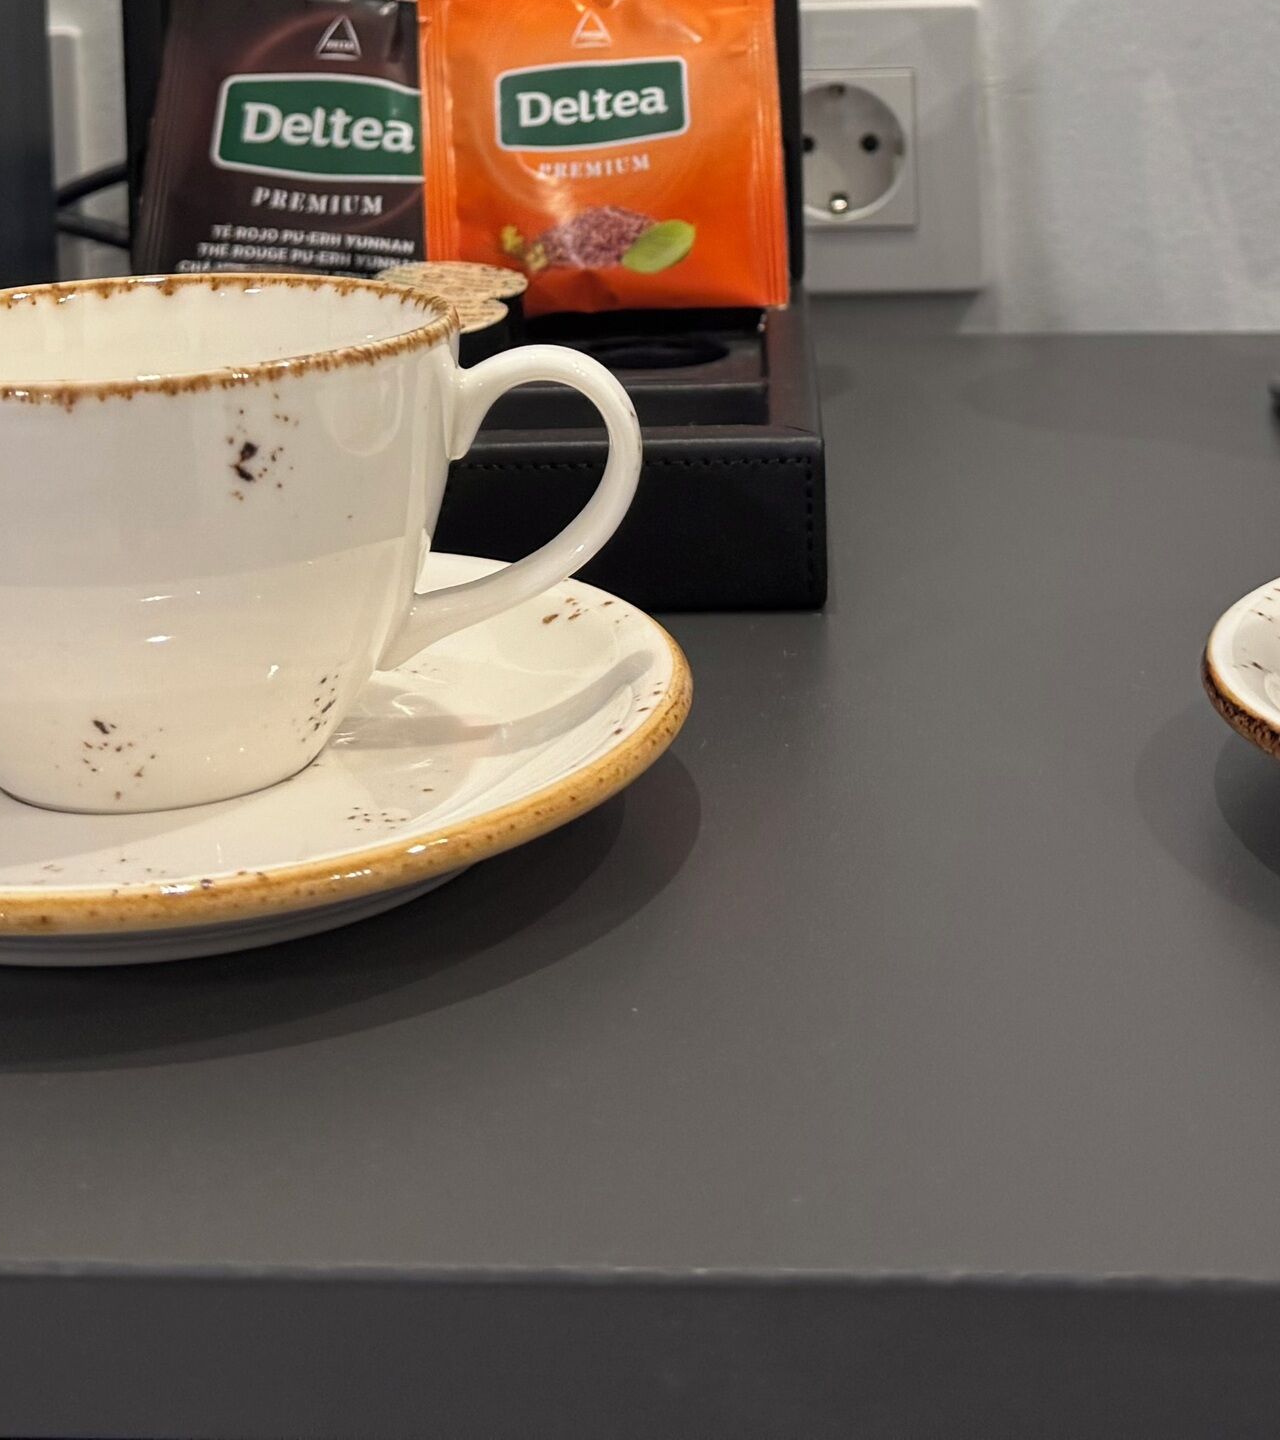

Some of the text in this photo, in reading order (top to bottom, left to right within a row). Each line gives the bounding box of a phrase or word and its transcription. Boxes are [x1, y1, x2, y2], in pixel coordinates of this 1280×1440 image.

[516, 86, 668, 127] Deltea
[241, 101, 415, 154] Deltea
[538, 154, 650, 178] PREMIUM
[252, 186, 383, 215] PREMIUM
[231, 243, 288, 261] ROUGE
[234, 225, 279, 243] ROJO
[281, 228, 342, 246] PU-ERH
[344, 233, 415, 254] YUNNAN
